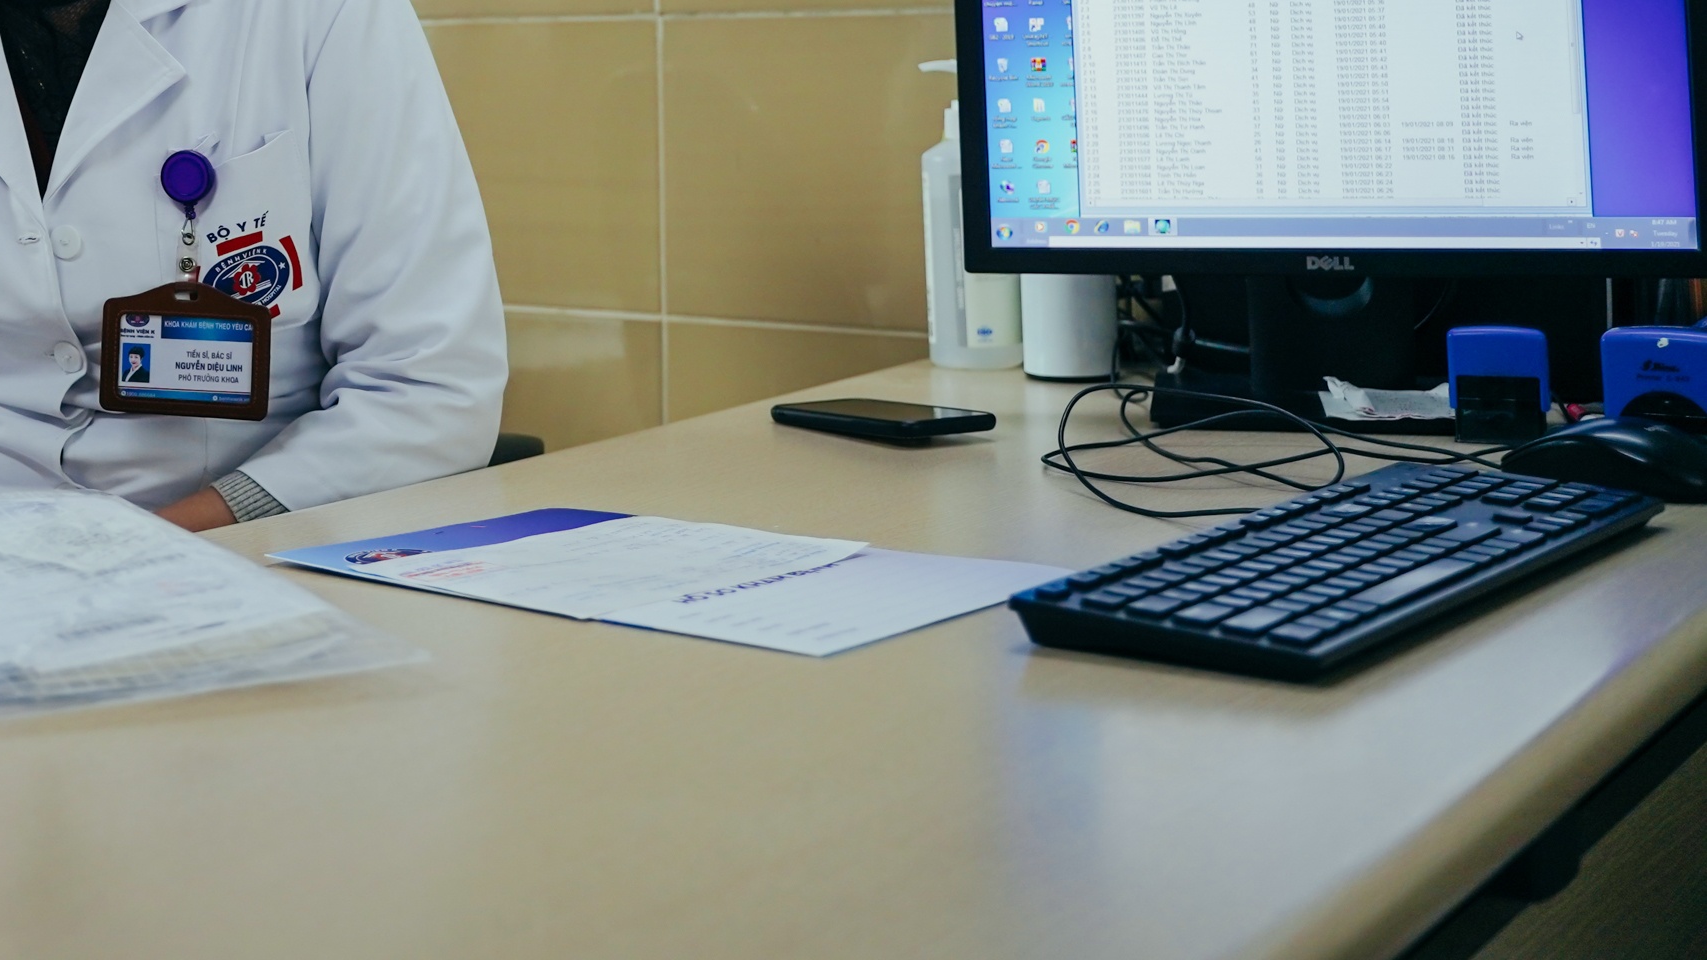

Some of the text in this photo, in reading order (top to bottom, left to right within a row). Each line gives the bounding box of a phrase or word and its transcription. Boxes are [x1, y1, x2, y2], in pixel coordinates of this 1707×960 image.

[206, 210, 269, 244] BỘ Y TẾ
[1306, 255, 1355, 270] DELL
[261, 284, 282, 305] HOSPITAL
[164, 320, 180, 328] KHOA
[181, 320, 198, 329] KHÁM
[198, 320, 215, 330] BỆNH
[215, 322, 231, 330] THEO
[186, 349, 201, 359] TIẾN
[211, 351, 225, 360] BÁC
[175, 359, 243, 373] NGUYỄN DIỆU LINH
[178, 373, 239, 384] PHÓ TRƯỞNG KHOA
